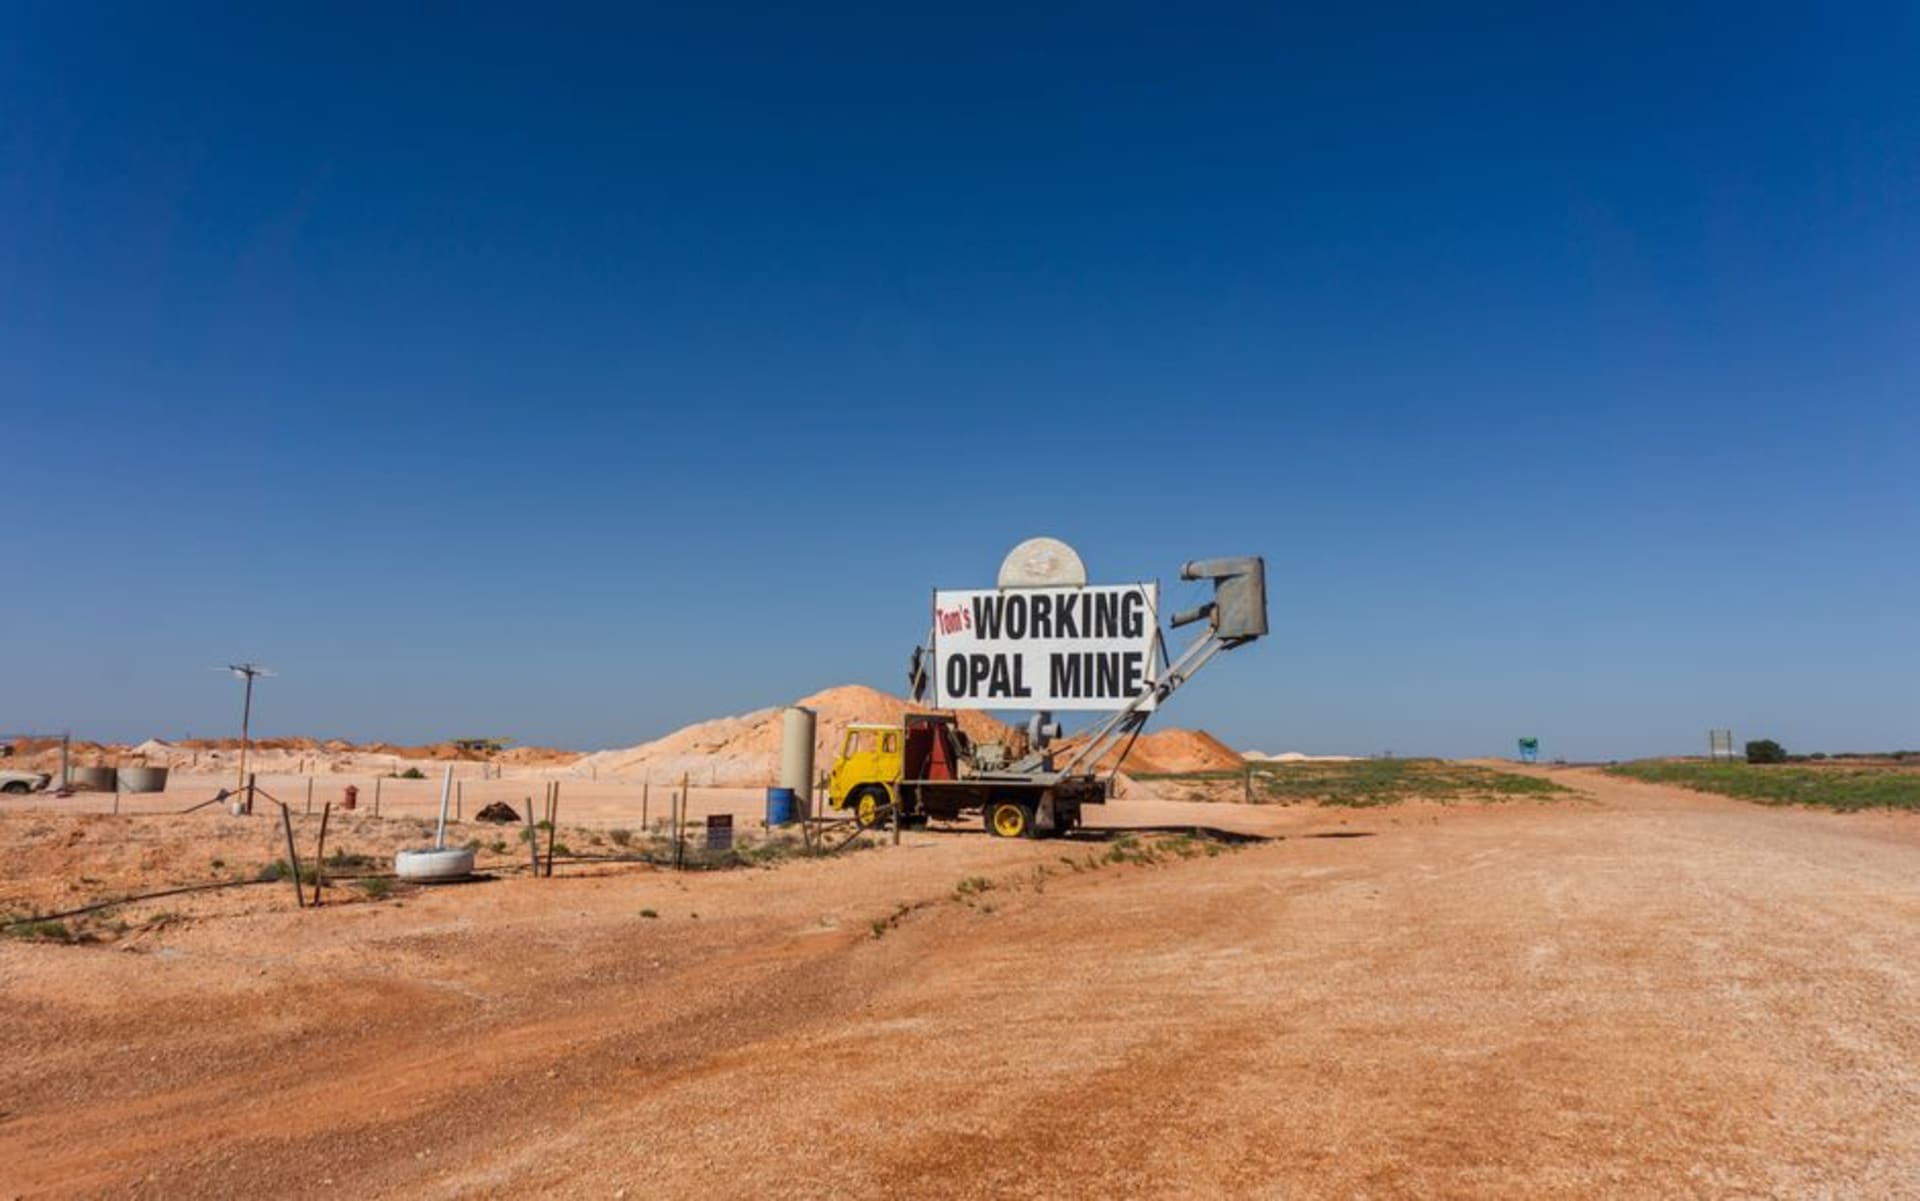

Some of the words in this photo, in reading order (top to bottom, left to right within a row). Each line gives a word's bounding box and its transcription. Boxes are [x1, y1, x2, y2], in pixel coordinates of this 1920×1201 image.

[936, 604, 971, 636] Tom's
[972, 590, 1144, 640] WORKING
[946, 652, 1031, 699] OPAL
[1050, 652, 1143, 698] MINE
